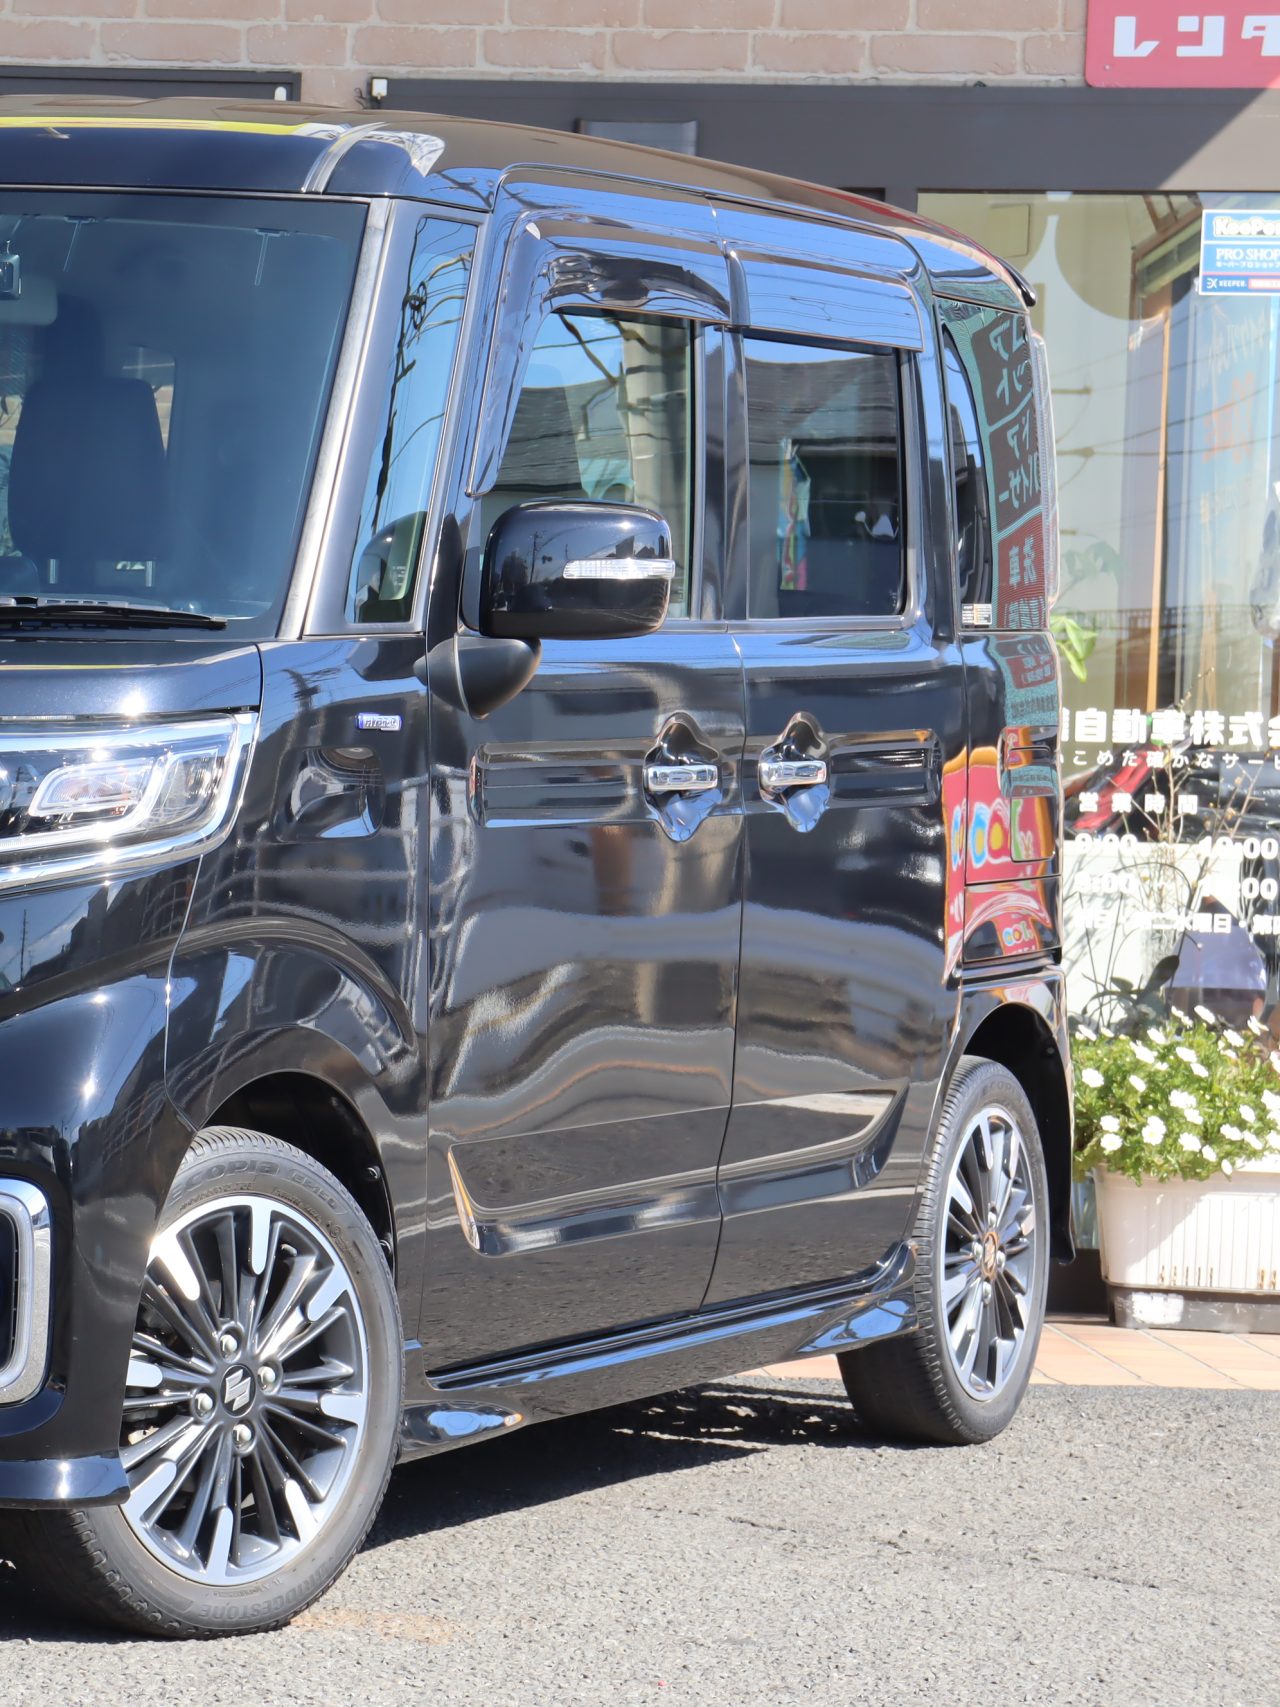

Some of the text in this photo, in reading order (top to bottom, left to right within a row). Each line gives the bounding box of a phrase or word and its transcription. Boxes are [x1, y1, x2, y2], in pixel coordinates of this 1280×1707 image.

[1113, 15, 1280, 57] レンタ
[1216, 248, 1244, 260] PRO
[1061, 708, 1280, 750] 自動車株式
[1059, 750, 1280, 770] こめた確かなサー
